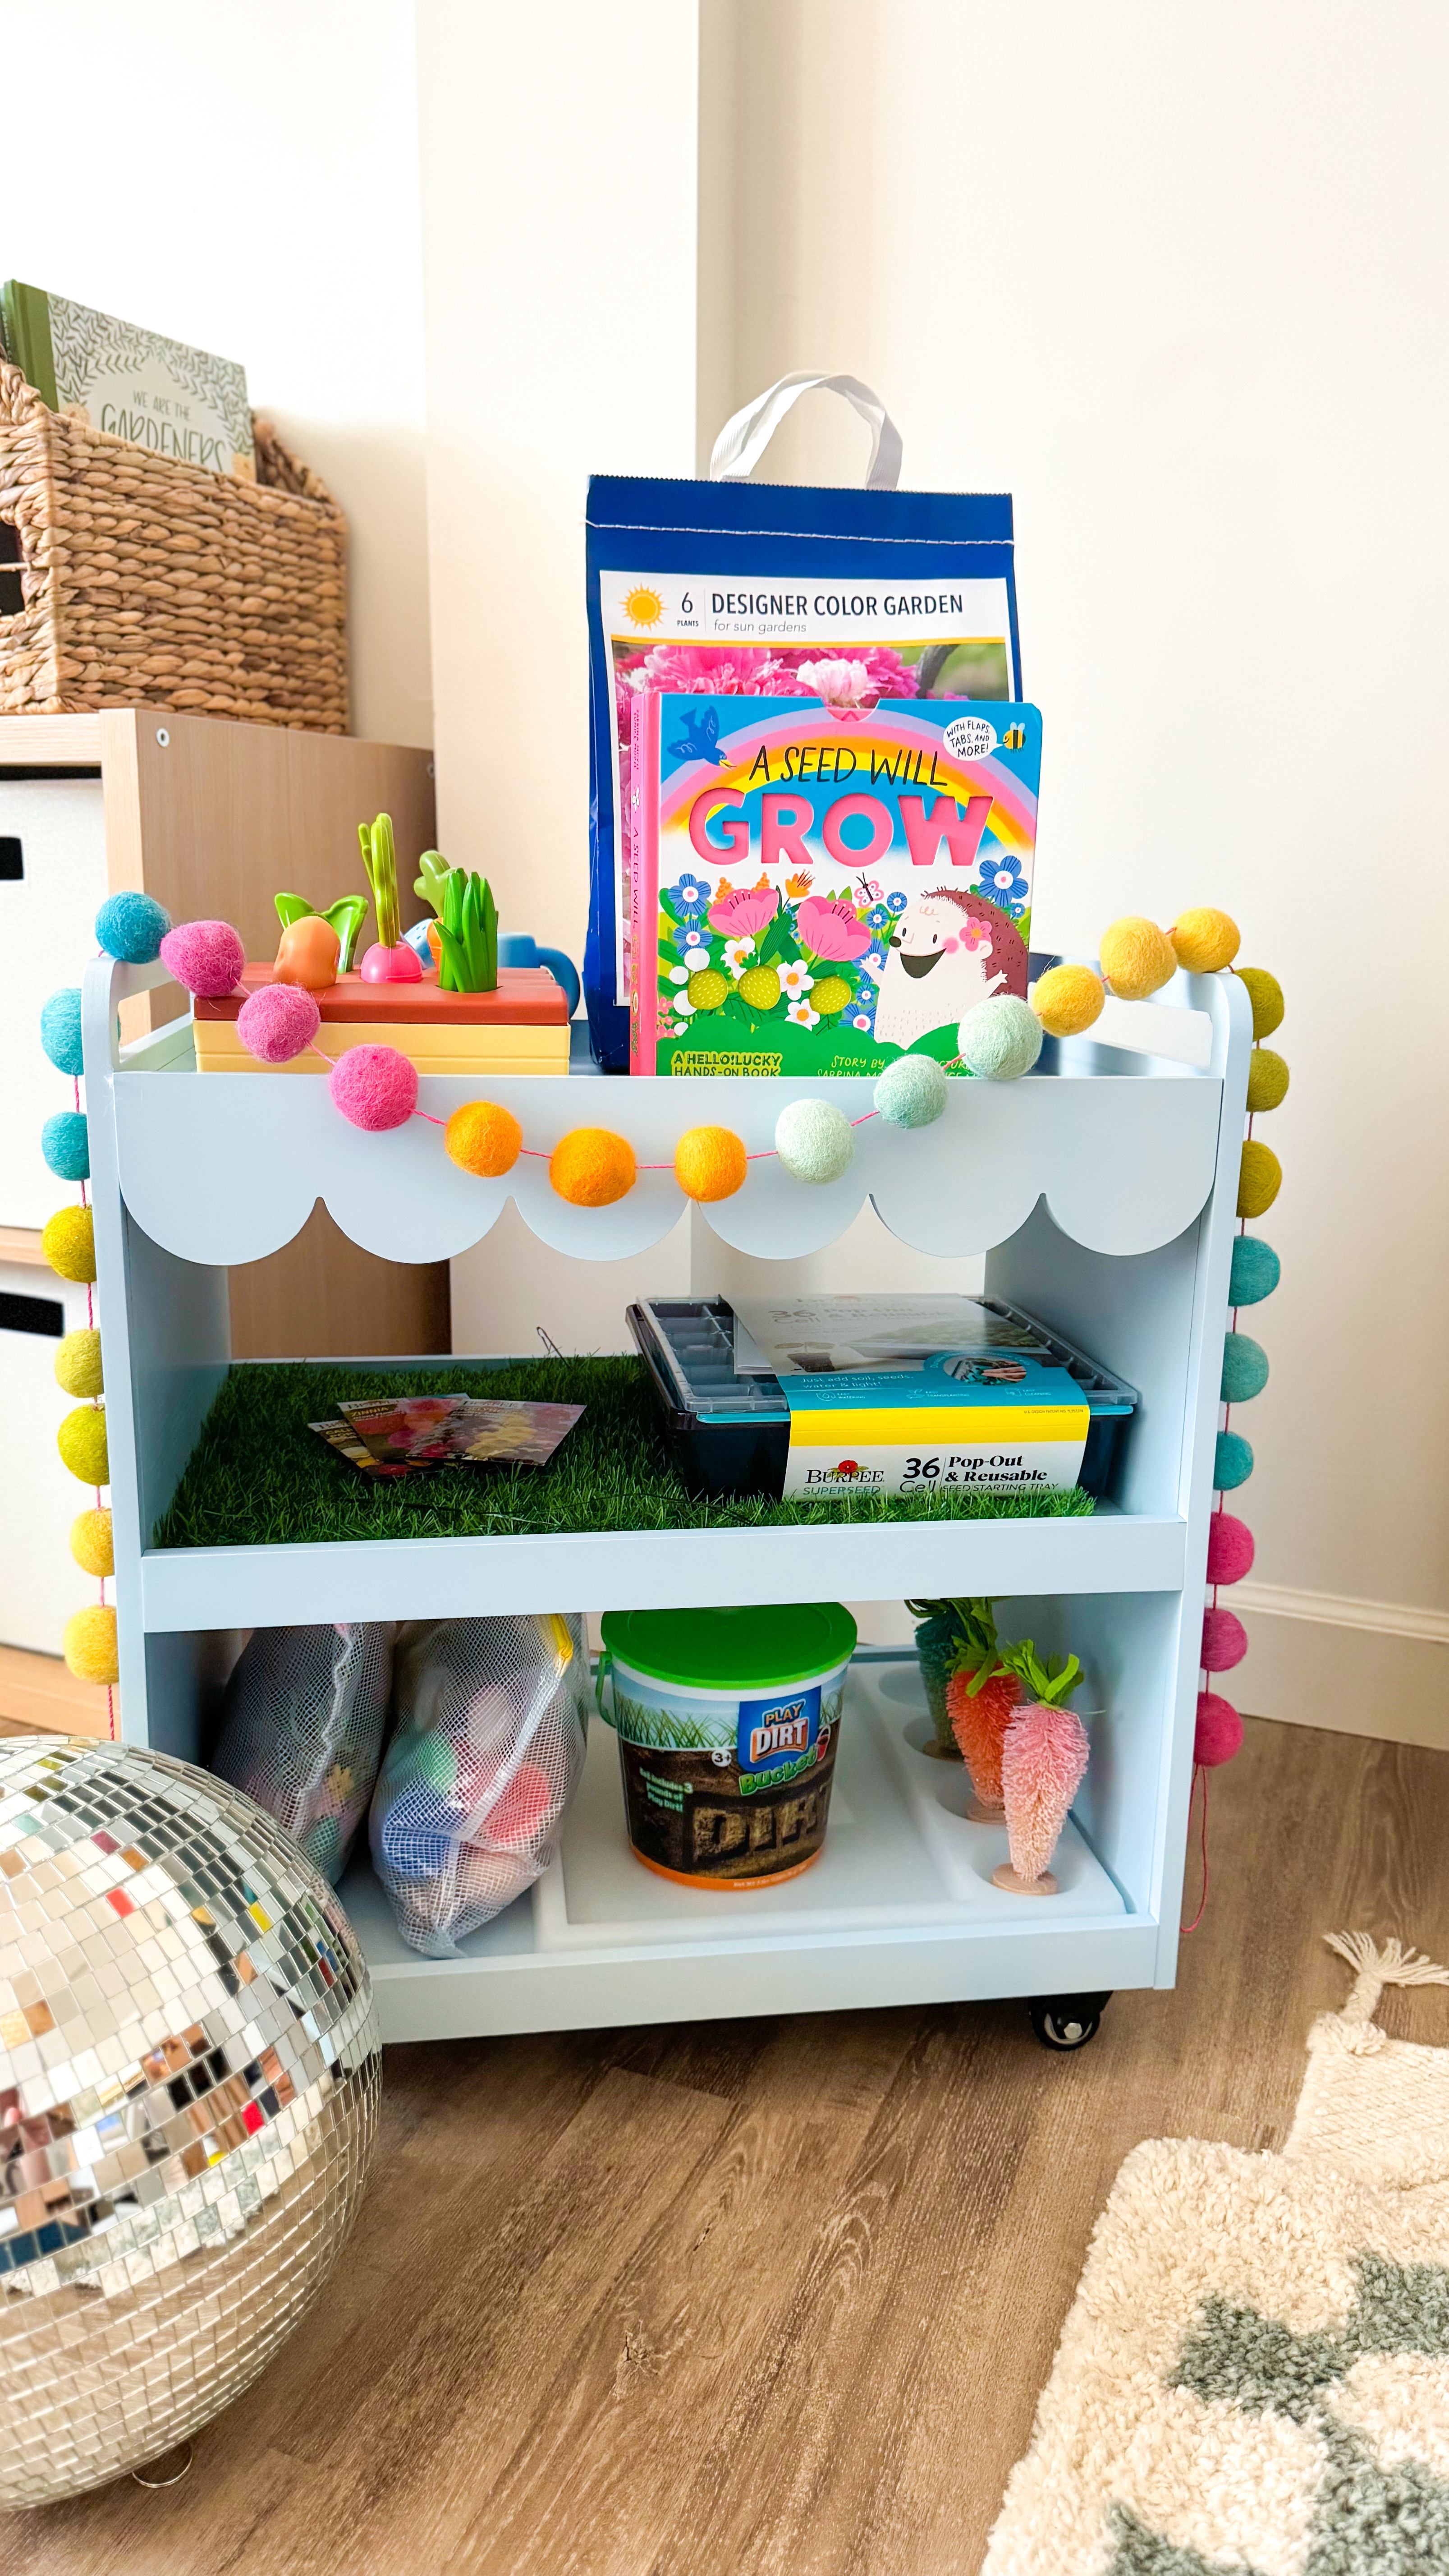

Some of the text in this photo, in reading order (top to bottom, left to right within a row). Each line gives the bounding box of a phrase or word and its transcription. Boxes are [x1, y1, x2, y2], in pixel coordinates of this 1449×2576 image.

[133, 391, 191, 421] WE ARE THE
[681, 592, 963, 616] 6 DESIGNER COLOR GARDEN
[714, 619, 807, 635] for sun gardens
[947, 722, 965, 738] WITH
[958, 743, 988, 758] MORE!
[748, 745, 948, 786] A SEED WILL
[633, 827, 638, 837] A
[688, 787, 994, 868] GROW
[674, 1053, 683, 1065] A
[831, 1055, 886, 1069] STORY BY
[675, 1066, 779, 1076] HANDS-ON BOOK
[903, 1457, 940, 1479] 36
[948, 1455, 1023, 1470] Pop-Out
[805, 1469, 885, 1484] BURPEE
[945, 1469, 1047, 1482] & Reusable
[803, 1486, 880, 1495] SUPERSEED
[899, 1480, 936, 1492] Cell
[764, 1702, 805, 1727] PLAY
[756, 1719, 807, 1756] DIRT
[714, 1752, 731, 1763] 3+
[683, 1782, 693, 1794] 3
